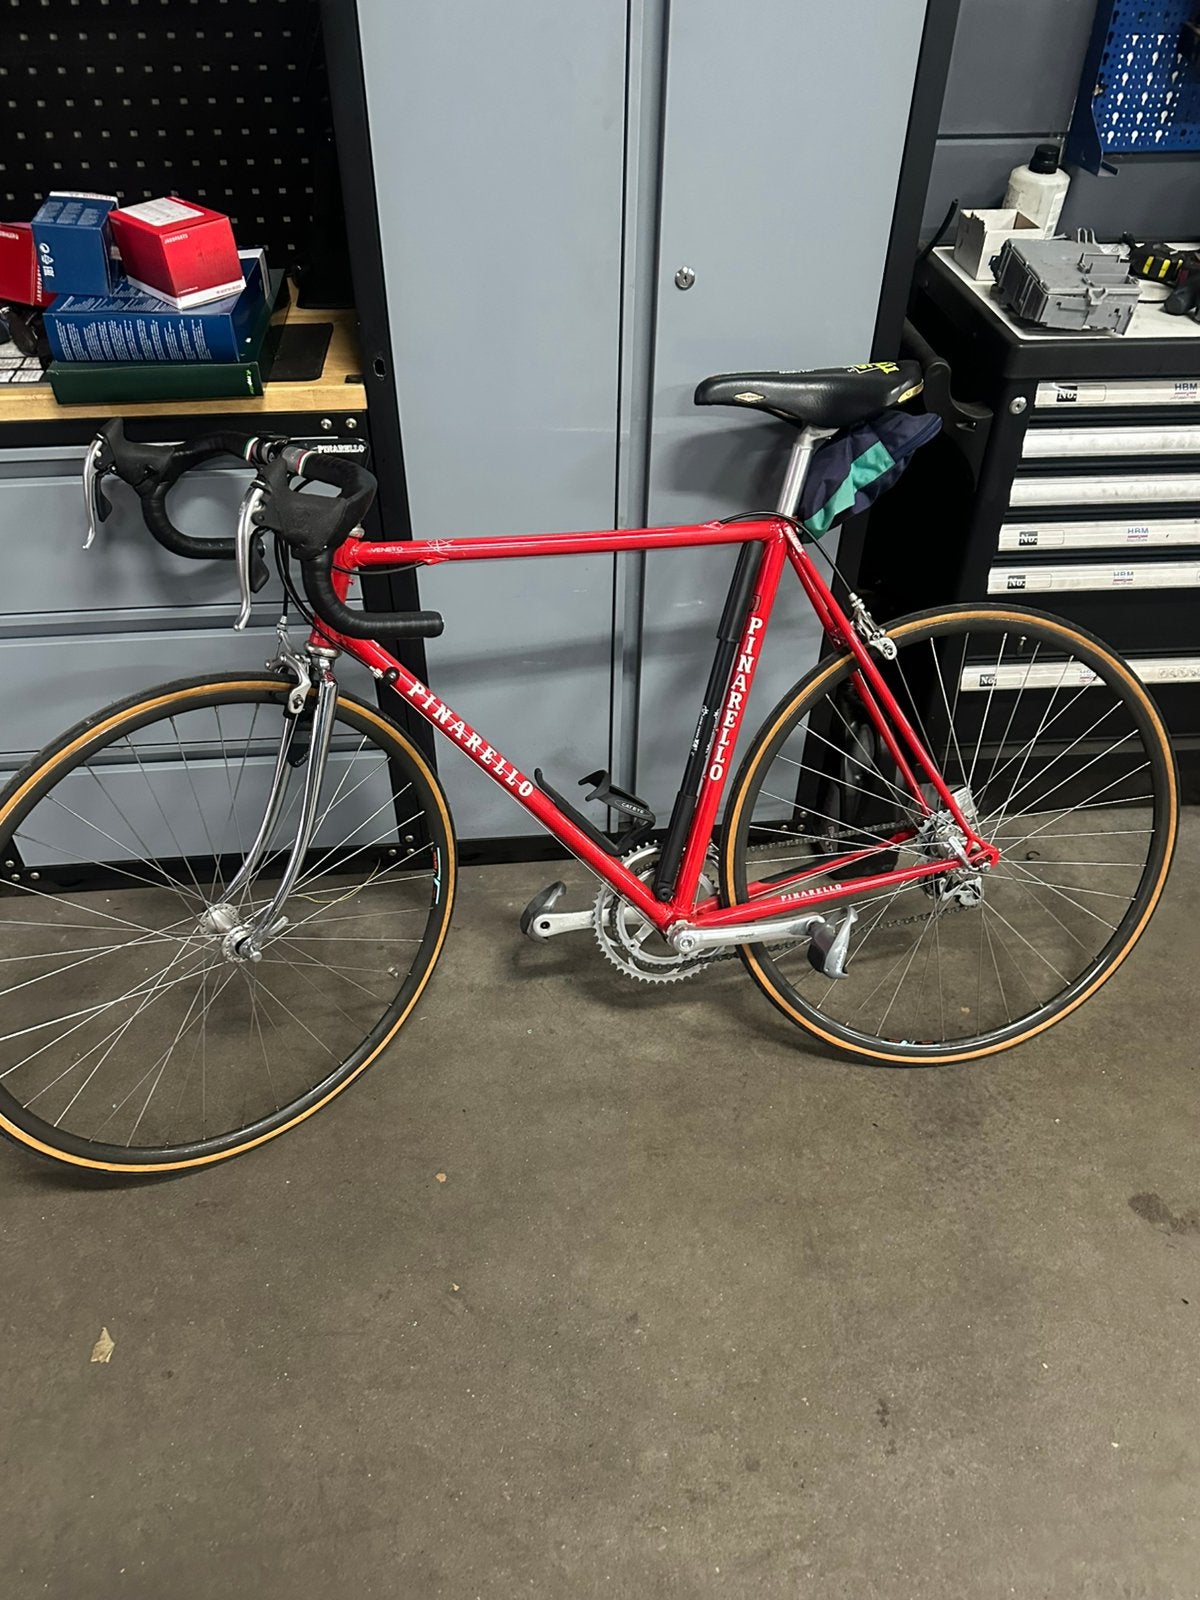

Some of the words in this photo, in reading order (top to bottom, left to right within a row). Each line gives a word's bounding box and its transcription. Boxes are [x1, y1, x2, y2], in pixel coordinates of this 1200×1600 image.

[1174, 382, 1198, 391] HBM
[709, 617, 763, 781] PINARELLO
[407, 680, 534, 797] PINARELLO
[780, 884, 843, 902] PINARELLO
